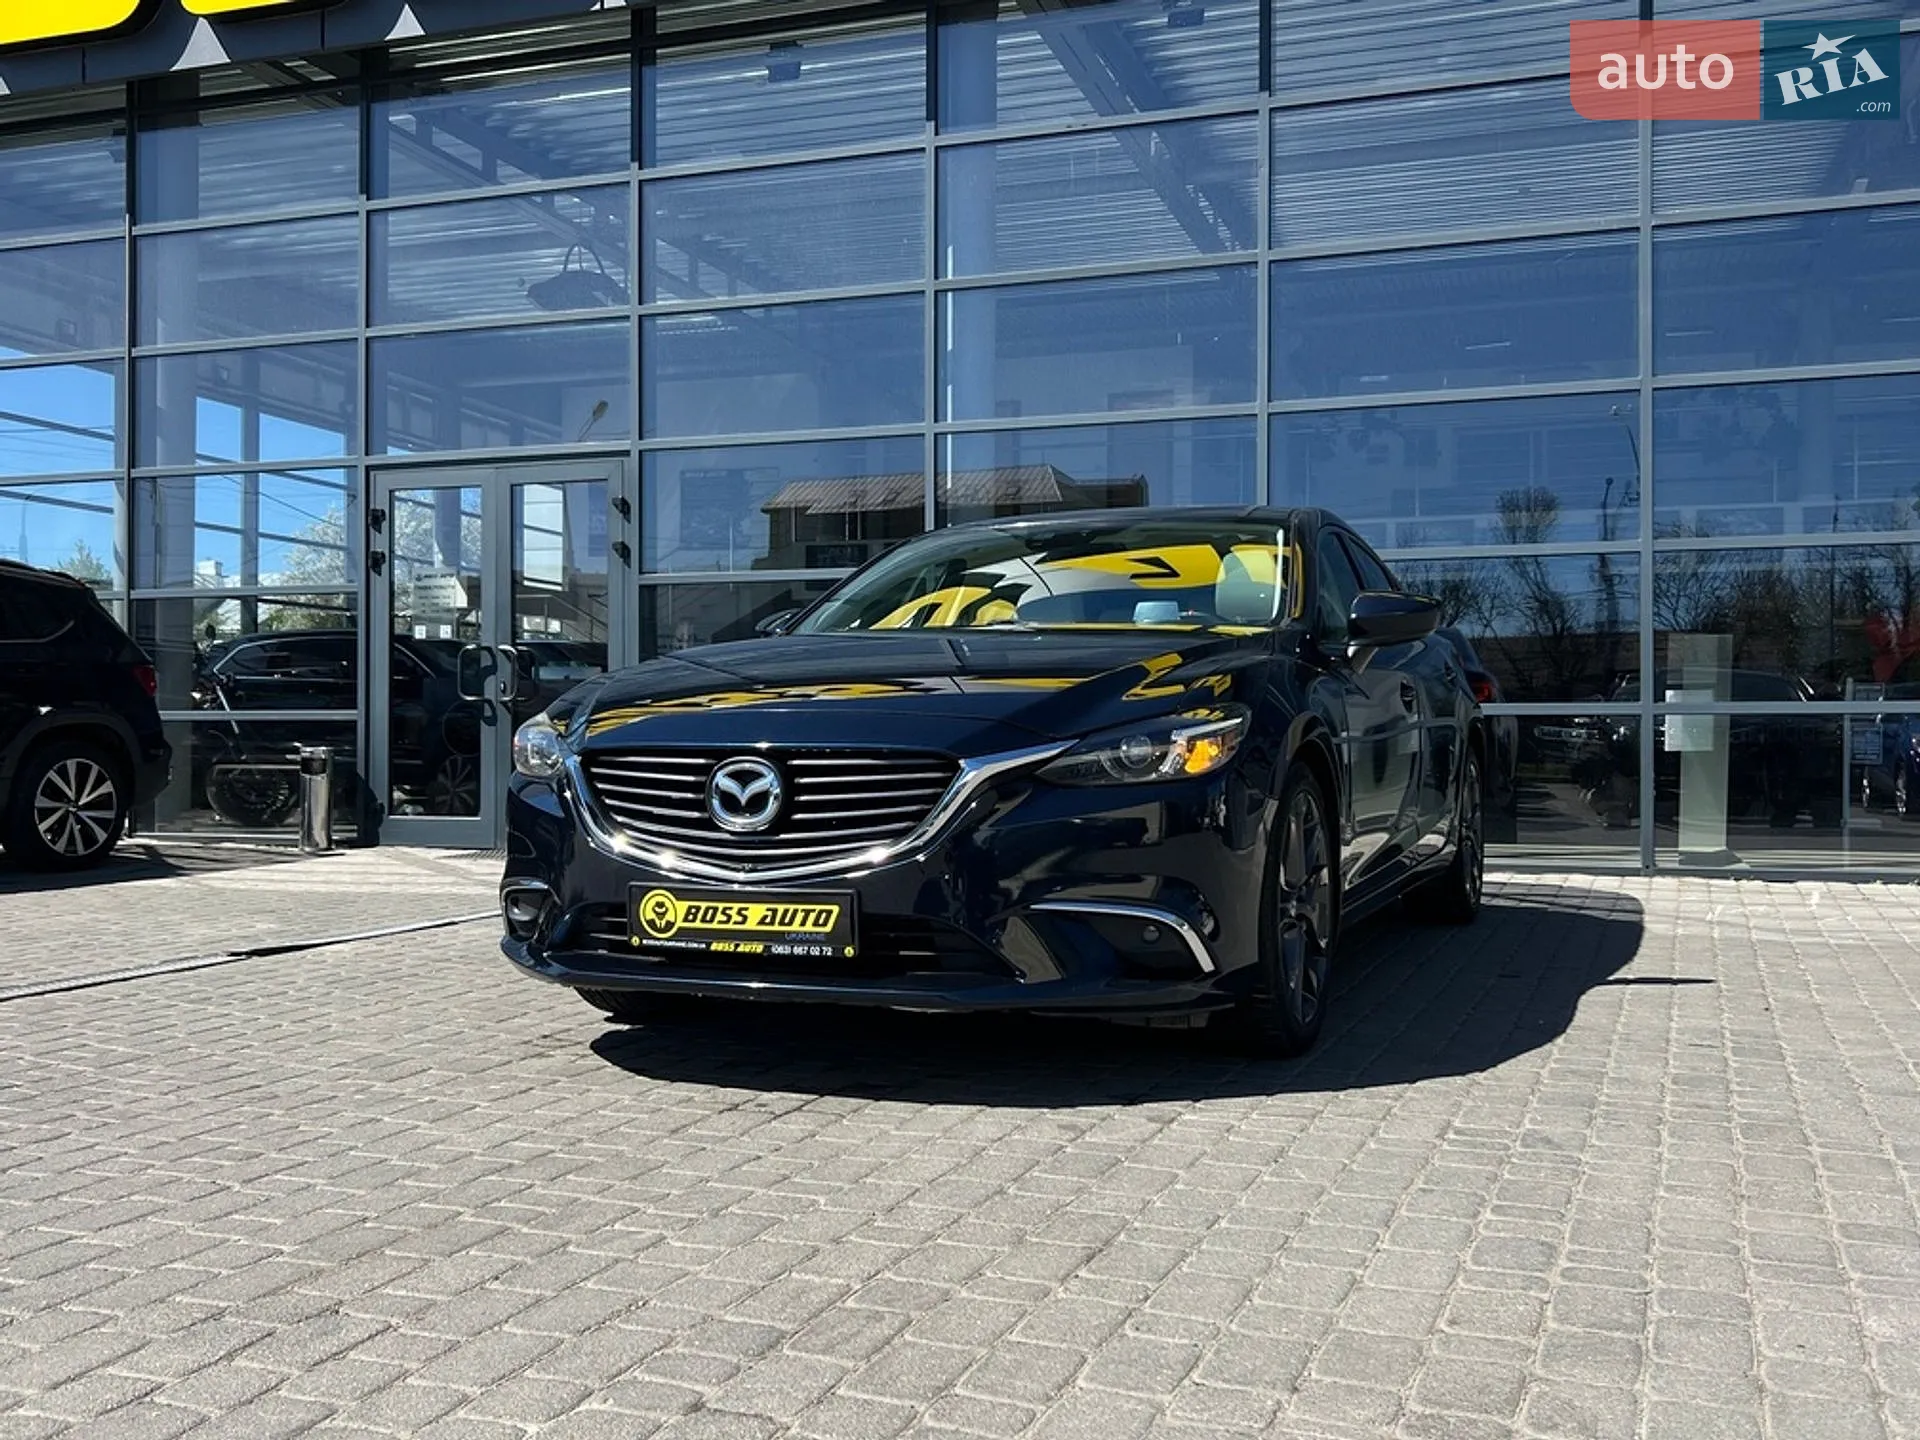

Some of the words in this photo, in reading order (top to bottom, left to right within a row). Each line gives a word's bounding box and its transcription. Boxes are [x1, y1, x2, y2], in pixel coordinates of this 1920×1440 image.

[682, 904, 751, 926] BOSS
[756, 907, 834, 928] AUTO
[822, 946, 833, 956] 72
